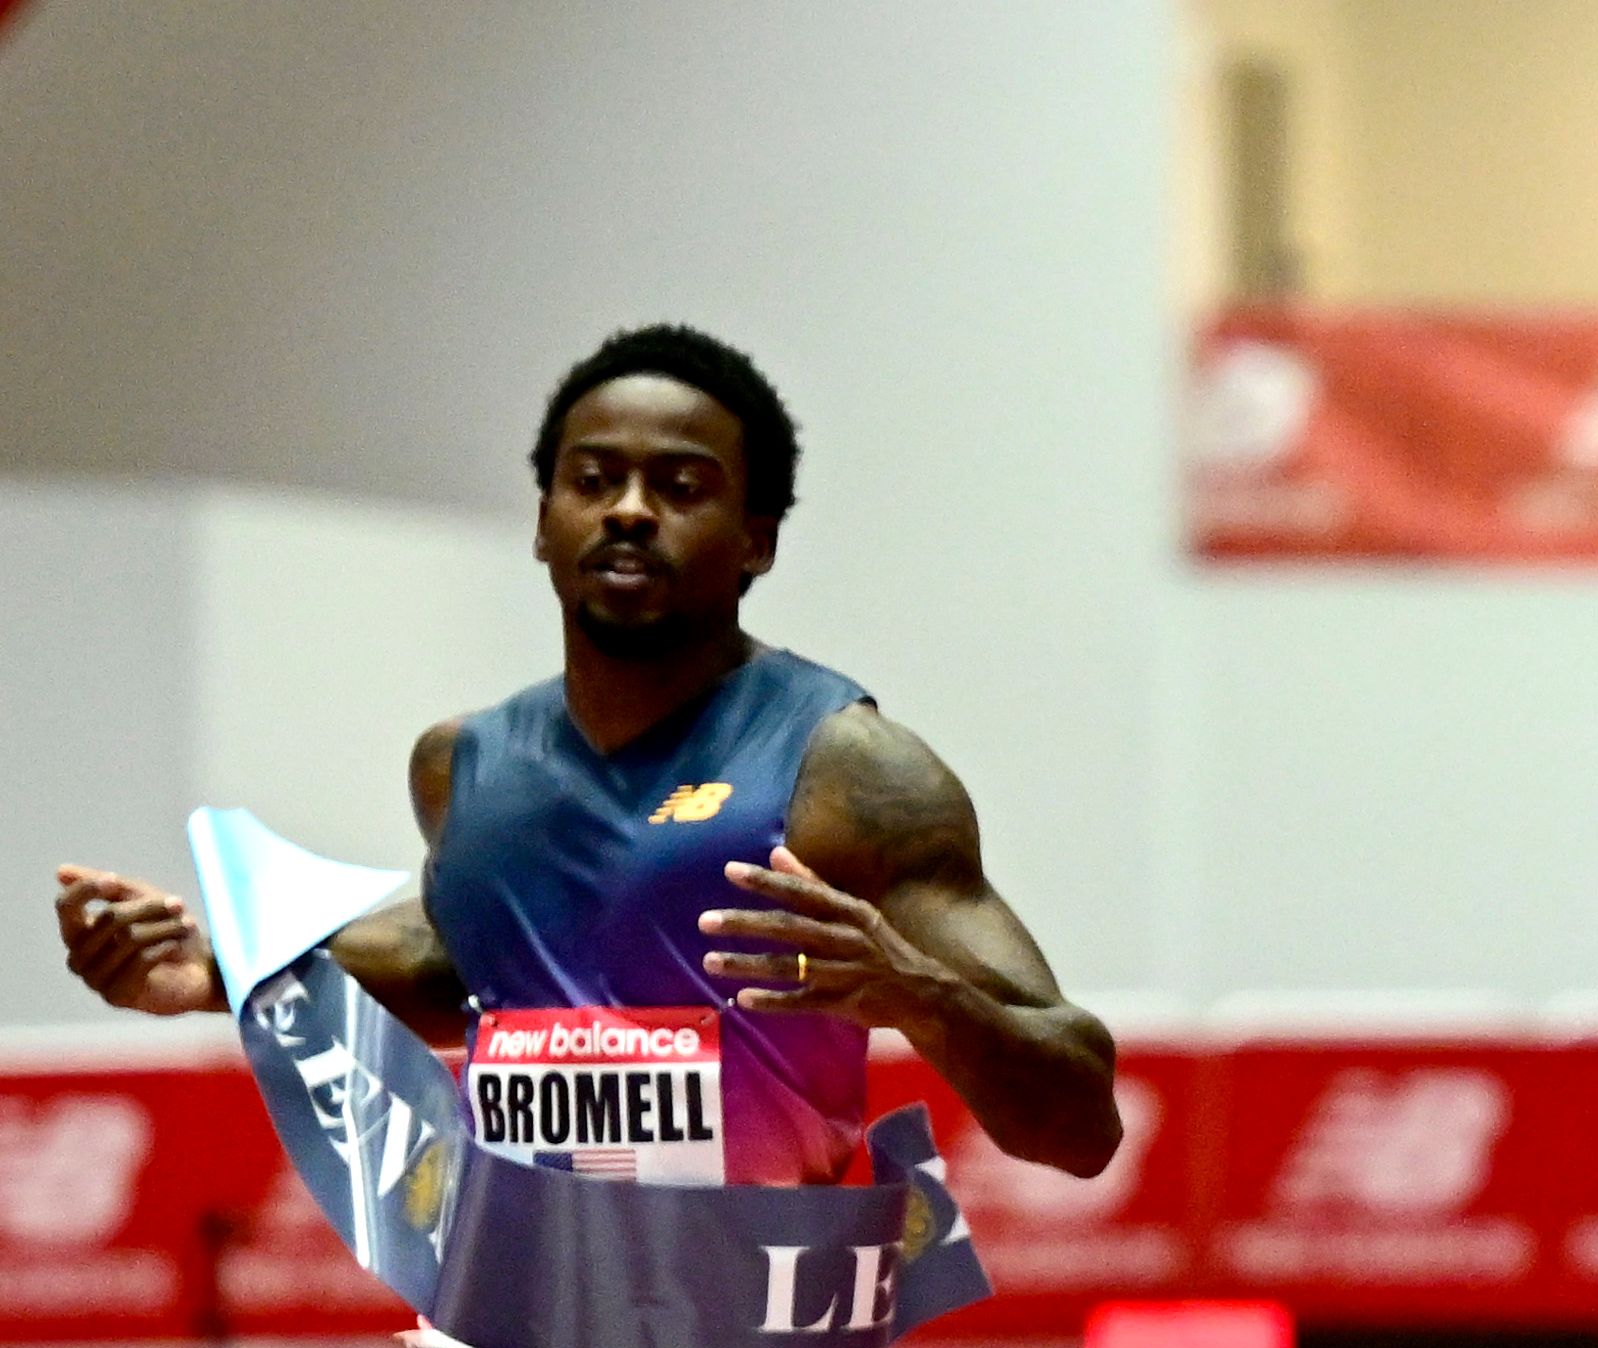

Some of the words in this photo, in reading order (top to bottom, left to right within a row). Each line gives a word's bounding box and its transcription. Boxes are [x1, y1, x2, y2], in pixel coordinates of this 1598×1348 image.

[488, 1028, 549, 1058] new
[549, 1021, 700, 1056] balance
[477, 1071, 713, 1144] BROMELL
